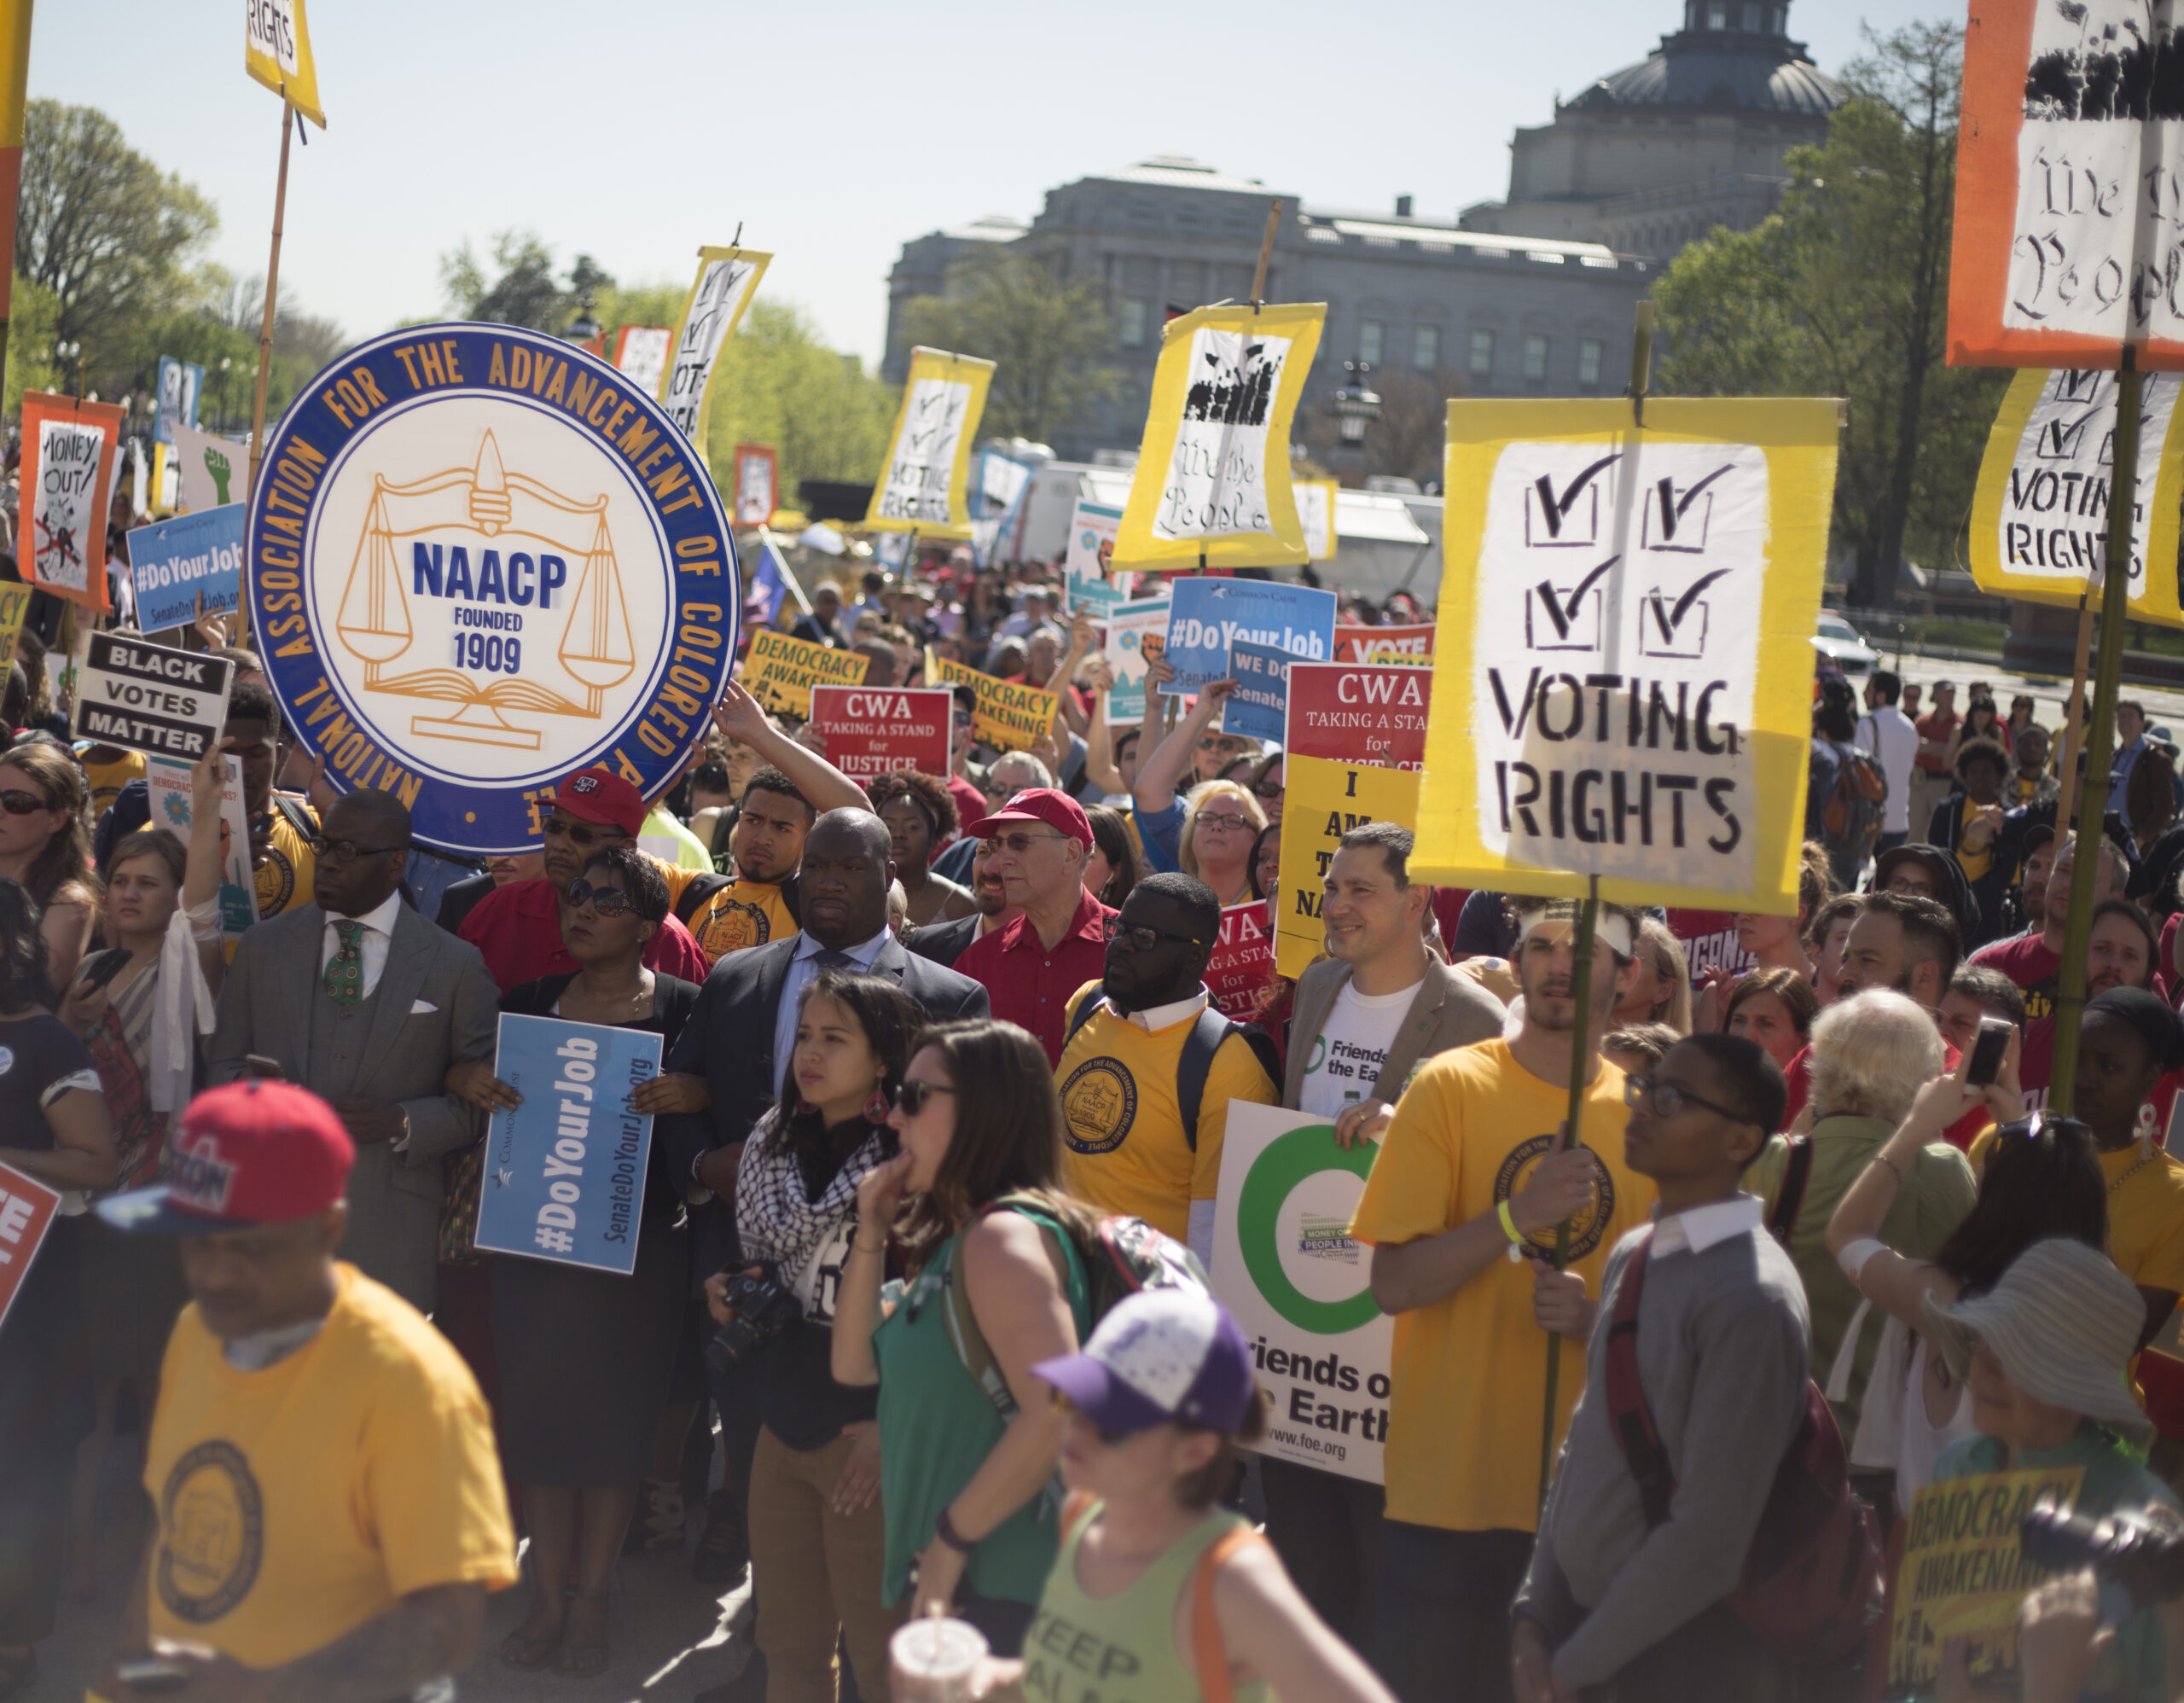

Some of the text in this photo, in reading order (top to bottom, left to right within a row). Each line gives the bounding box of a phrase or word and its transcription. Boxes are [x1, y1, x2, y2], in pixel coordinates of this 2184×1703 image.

[393, 340, 465, 390] THE
[322, 366, 389, 430] FOR
[487, 342, 705, 515] ADVANCEMENT
[43, 432, 99, 466] MONEY
[44, 461, 97, 498] OUT!
[1159, 486, 1269, 535] People
[259, 433, 328, 659] ASSOCIATION
[675, 535, 722, 578] OF
[414, 541, 567, 610] NAACP
[454, 607, 524, 632] FOUNDED
[108, 645, 206, 683] BLACK
[454, 631, 522, 675] 1909
[755, 636, 865, 680] DEMOCRACY
[1235, 652, 1263, 673] WE
[1350, 636, 1427, 665] VOTE
[637, 602, 723, 758] COLORED
[943, 664, 1054, 716] DEMOCRACY
[1233, 683, 1285, 711] Senate
[1337, 672, 1424, 706] CWA
[105, 680, 198, 717] VOTES
[845, 694, 913, 719] CWA
[1487, 665, 1748, 756] VOTING
[88, 711, 204, 754] MATTER
[822, 721, 936, 738] TAKING A STAND
[978, 700, 1048, 737] AKENING
[1306, 711, 1372, 729] TAKING
[1376, 713, 1391, 729] A
[868, 739, 889, 753] for
[1365, 735, 1391, 751] for
[839, 754, 917, 773] JUSTICE
[152, 776, 193, 793] DEMOCRAC
[1345, 770, 1358, 798] I
[1494, 760, 1742, 854] RIGHTS
[1323, 811, 1372, 838] AM
[1211, 912, 1263, 949] WA
[1227, 953, 1238, 968] A
[1222, 974, 1245, 989] for
[1327, 1059, 1355, 1078] the
[1330, 1039, 1389, 1065] Friends
[1080, 1062, 1093, 1073] FOR
[1093, 1059, 1106, 1067] THE
[1105, 1060, 1134, 1100] ADVANCEMENT
[1126, 1101, 1134, 1112] OF
[1079, 1108, 1096, 1121] 1909
[1082, 1096, 1107, 1110] NAACP
[534, 1037, 599, 1253] #DoYourJob
[1515, 1145, 1534, 1161] FOR
[1533, 1139, 1550, 1150] THE
[1305, 1239, 1343, 1250] PEOPLE
[1308, 1229, 1337, 1238] MONEY
